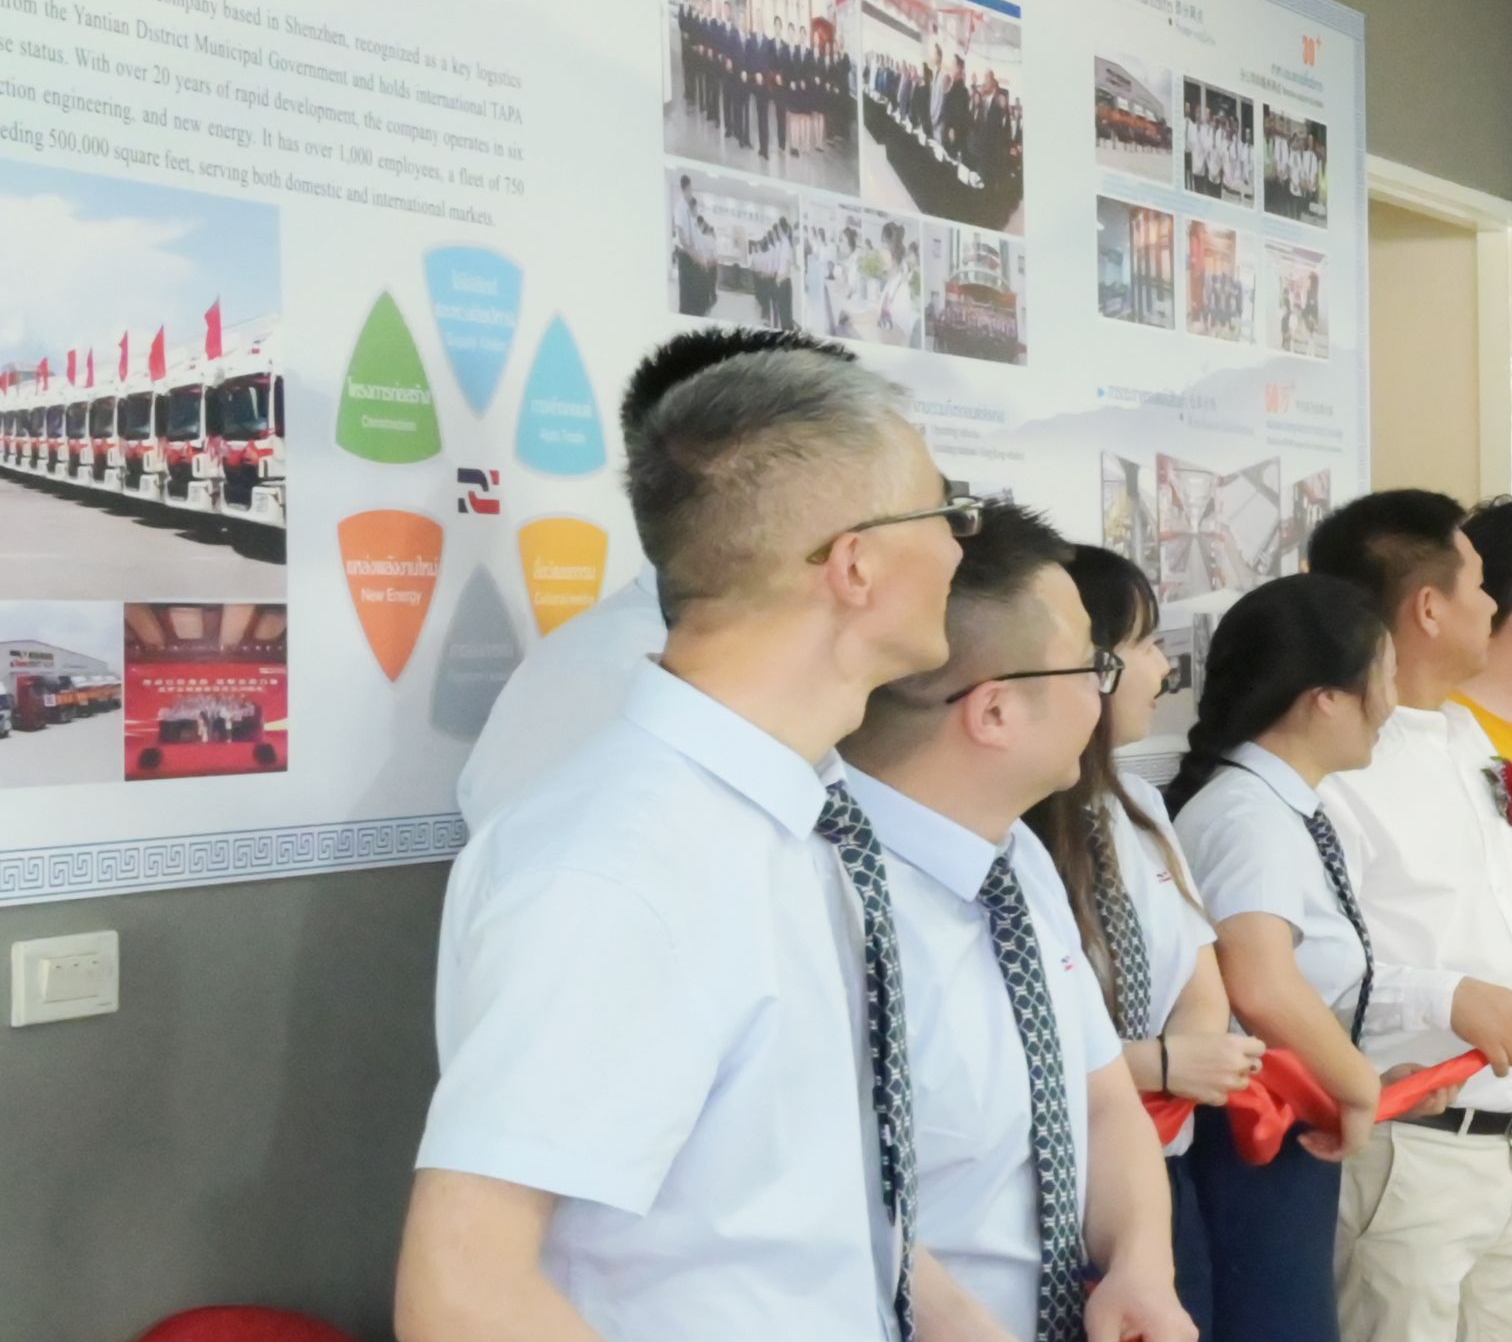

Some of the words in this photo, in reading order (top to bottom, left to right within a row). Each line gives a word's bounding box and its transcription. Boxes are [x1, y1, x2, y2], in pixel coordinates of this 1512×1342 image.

[19, 38, 70, 66] status.
[74, 46, 111, 74] With
[116, 60, 148, 82] over
[152, 64, 171, 86] 20
[175, 71, 213, 97] years
[216, 79, 231, 99] of
[235, 86, 269, 111] rapid
[274, 90, 360, 128] development,
[364, 112, 383, 132] the
[386, 121, 438, 150] company
[73, 3, 129, 36] Yantian
[136, 19, 189, 51] District
[194, 32, 263, 67] Municipal
[268, 51, 348, 86] Government
[352, 69, 375, 92] and
[379, 76, 411, 100] holds
[415, 85, 487, 118] international
[491, 100, 523, 126] TAPA
[267, 11, 280, 32] in
[284, 14, 350, 50] Shenzhen,
[355, 35, 420, 65] recognized
[43, 84, 136, 124] engineering,
[142, 106, 168, 128] and
[174, 114, 201, 133] new
[207, 120, 256, 150] energy.
[263, 127, 273, 149] It
[278, 130, 299, 153] has
[305, 141, 333, 160] over
[505, 175, 524, 198] 750
[113, 144, 160, 171] square
[164, 149, 194, 174] feet,
[199, 157, 248, 188] serving
[252, 166, 281, 189] both
[285, 172, 342, 200] domestic
[346, 184, 368, 205] and
[372, 189, 445, 219] international
